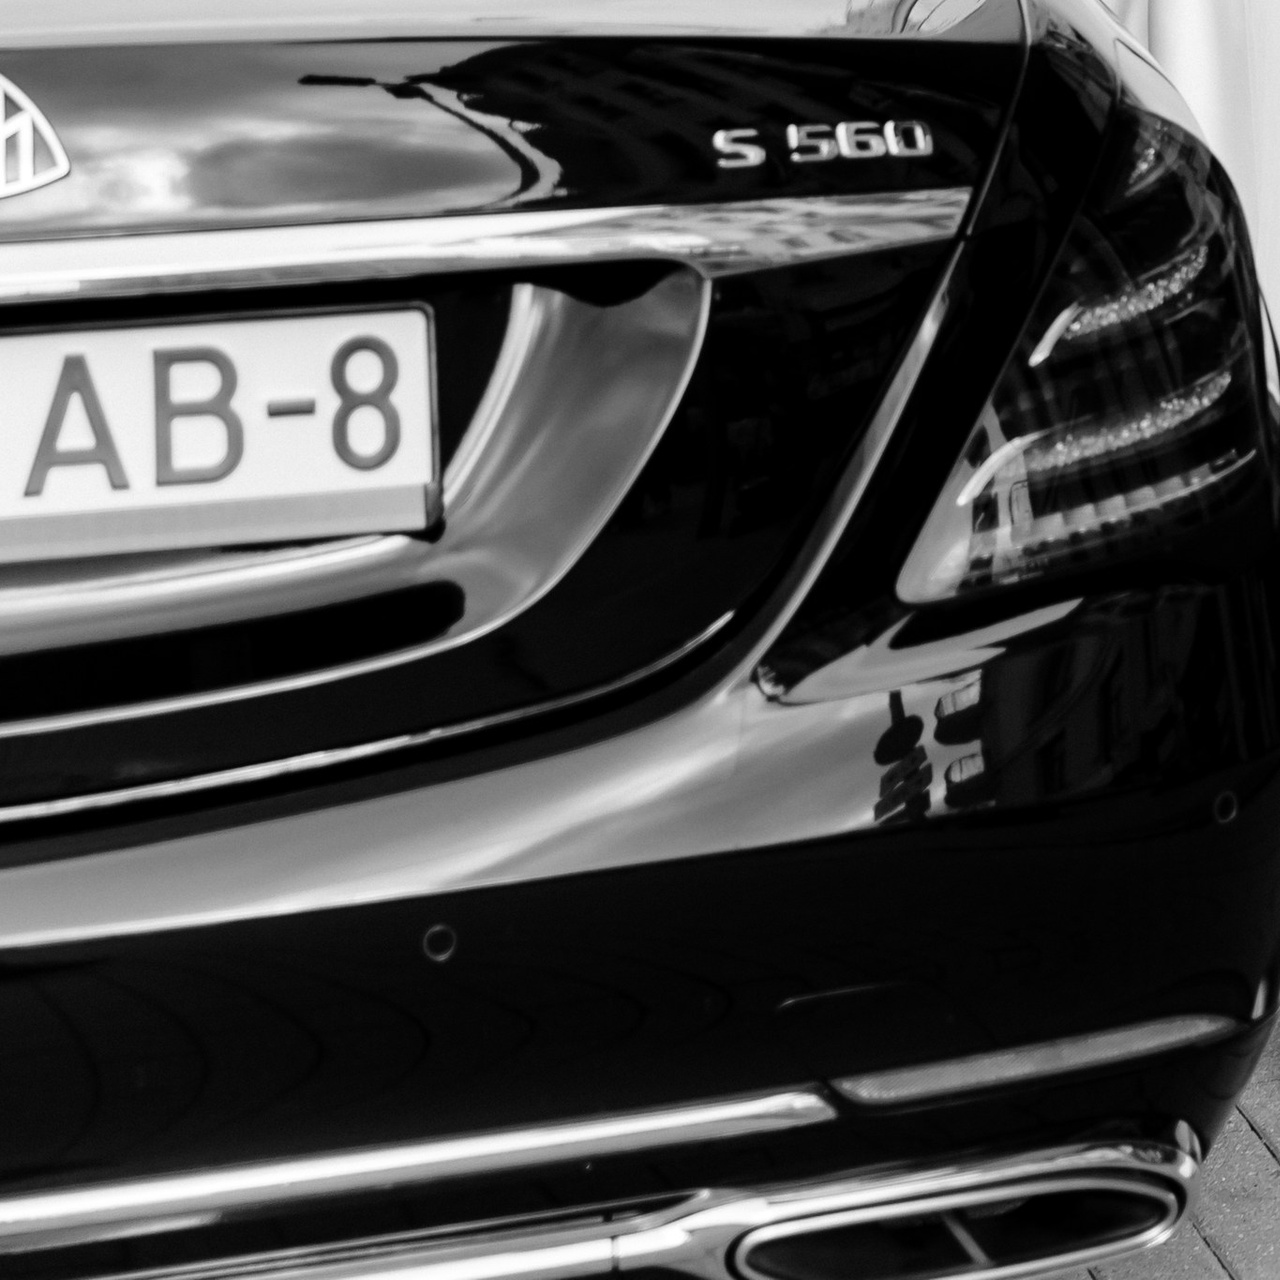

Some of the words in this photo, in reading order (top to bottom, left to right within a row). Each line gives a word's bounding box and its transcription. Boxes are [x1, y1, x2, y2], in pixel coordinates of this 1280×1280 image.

[712, 128, 767, 168] S
[786, 120, 934, 163] 560
[23, 335, 402, 498] AB-8
